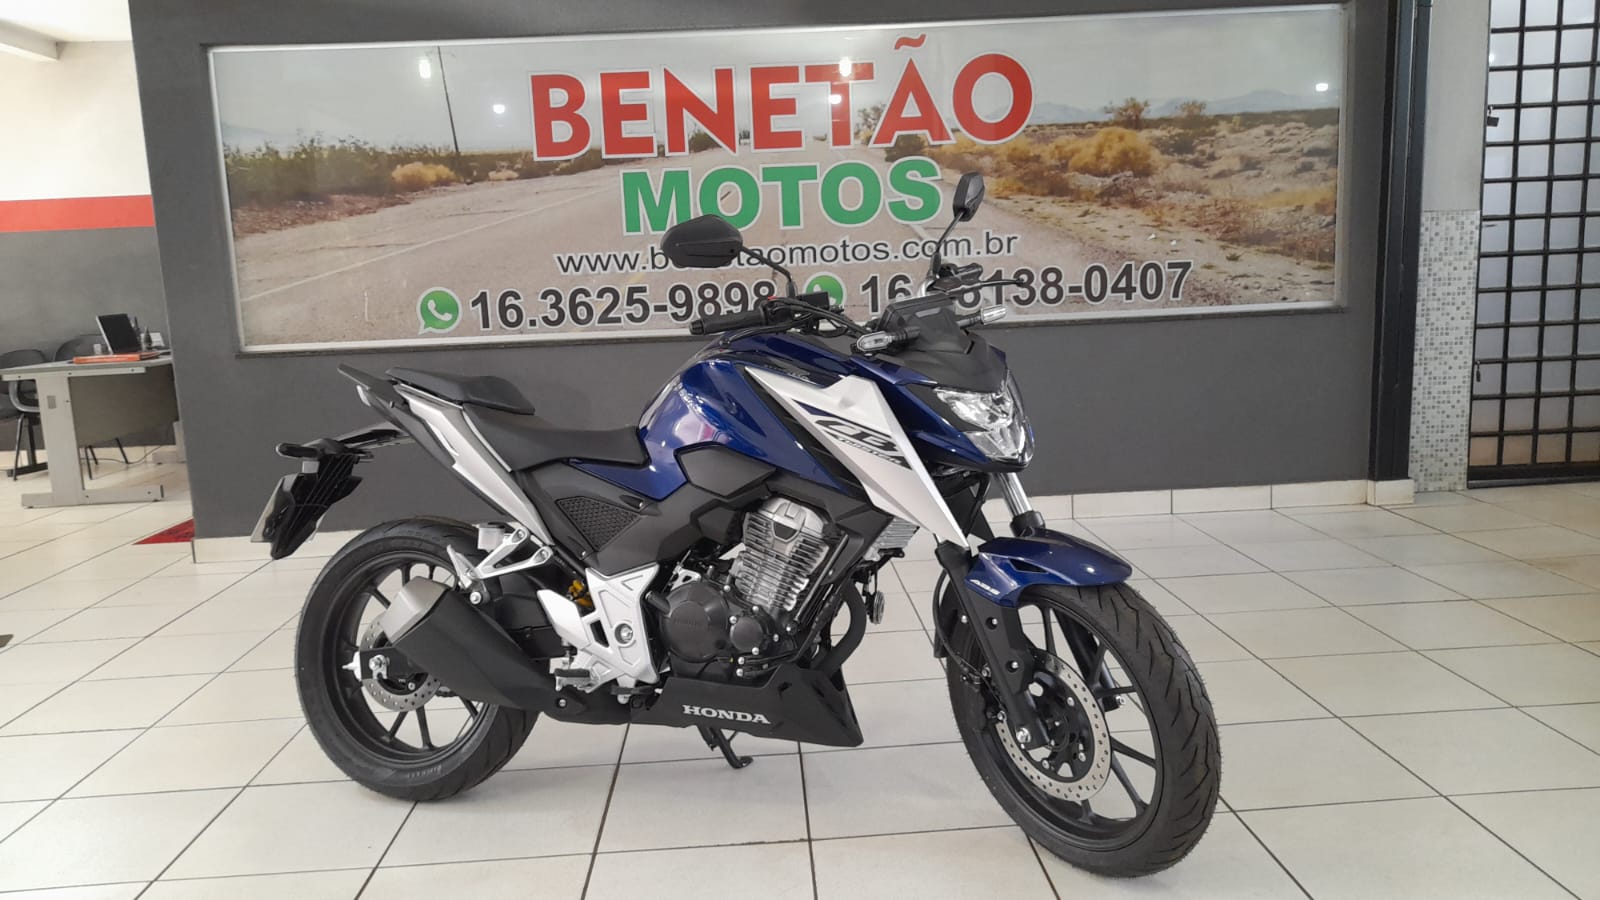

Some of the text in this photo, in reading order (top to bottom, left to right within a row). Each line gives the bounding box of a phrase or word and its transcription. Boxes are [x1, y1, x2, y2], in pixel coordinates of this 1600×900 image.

[530, 34, 1034, 160] BENETÃO
[621, 157, 942, 234] MOTOS
[556, 231, 1018, 273] www.btaomotos.com.br
[682, 704, 771, 725] HONDA
